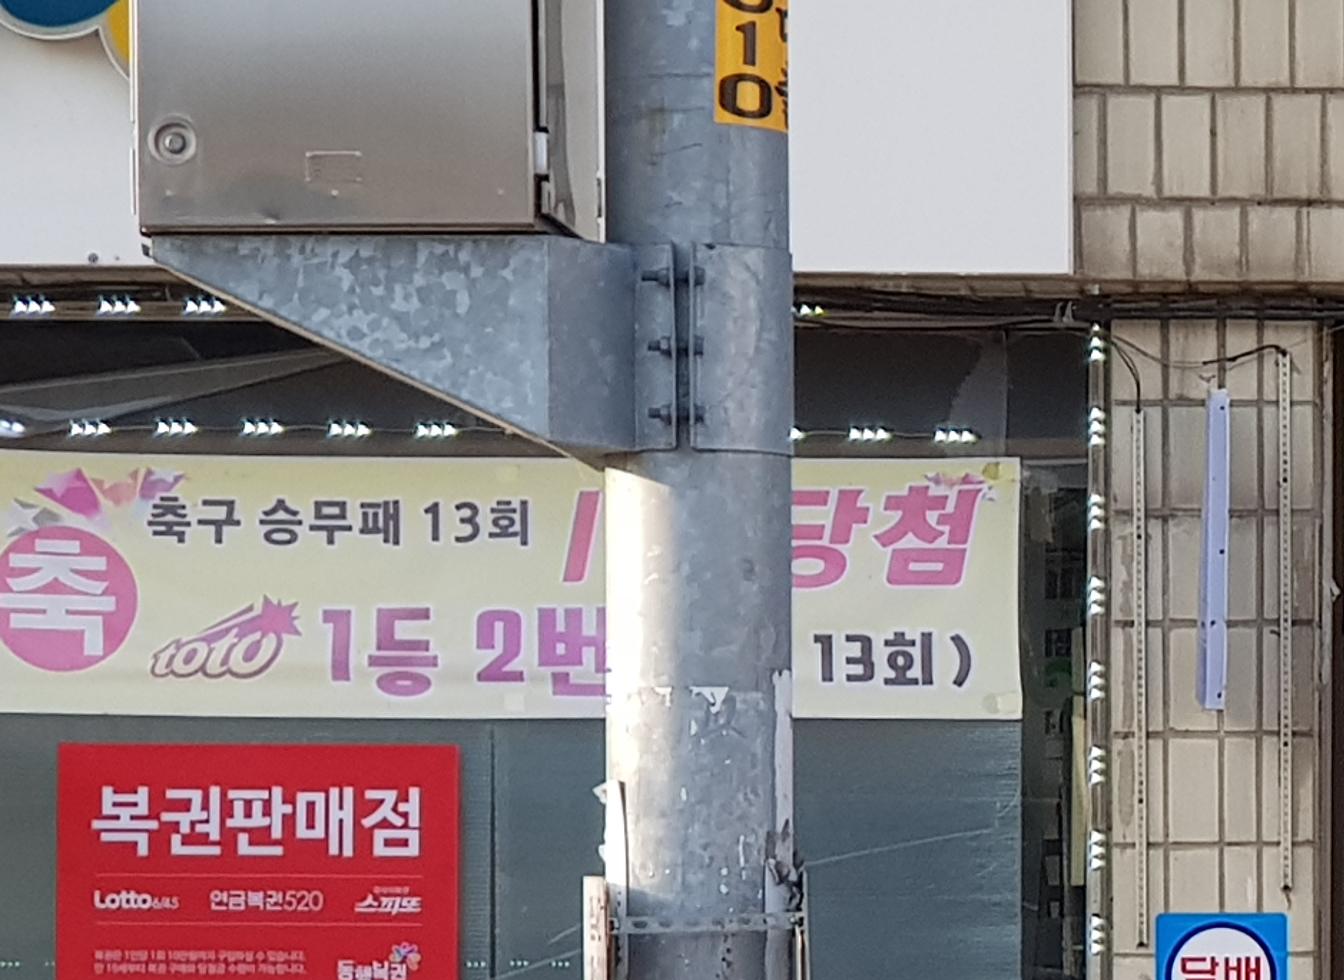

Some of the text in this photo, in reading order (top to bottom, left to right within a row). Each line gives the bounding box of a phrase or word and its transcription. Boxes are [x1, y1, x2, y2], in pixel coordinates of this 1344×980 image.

[718, 0, 773, 119] 10
[146, 497, 241, 545] 축구
[258, 499, 402, 546] 승무패
[423, 499, 531, 546] 13회
[791, 485, 982, 587] 당첨
[8, 539, 116, 656] 축
[321, 606, 974, 697] 1등 2번 13회)
[91, 785, 423, 858] 복권판매점
[209, 890, 324, 911] 연금복권520
